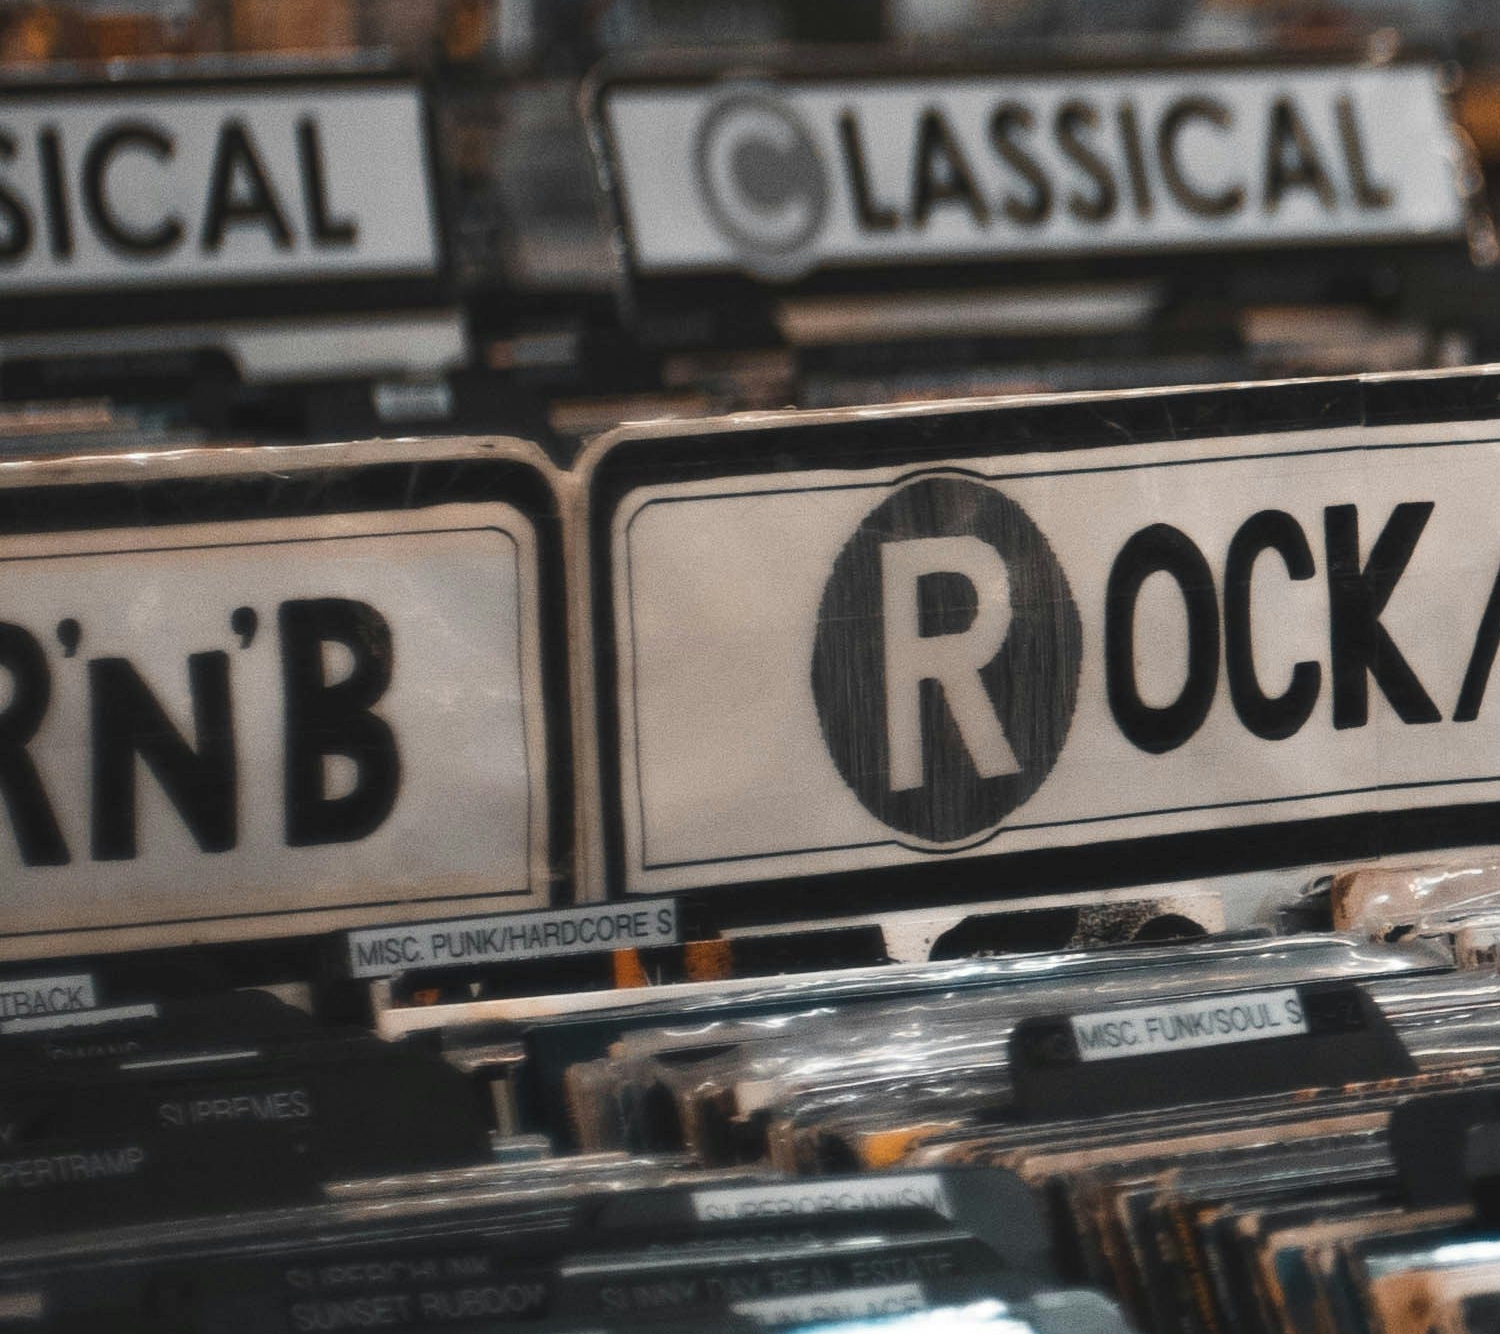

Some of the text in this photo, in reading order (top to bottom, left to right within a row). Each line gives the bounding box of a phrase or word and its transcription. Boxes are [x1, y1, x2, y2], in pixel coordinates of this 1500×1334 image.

[710, 91, 1391, 245] CLASSICAL
[356, 931, 425, 968] MISC.
[431, 912, 652, 959] PUNK/HARDCORE
[1080, 1022, 1140, 1050] MISC.
[1146, 1002, 1281, 1043] FUNK/SOUL
[158, 1090, 311, 1125] SUPREMES
[290, 1294, 411, 1332] SUNSET
